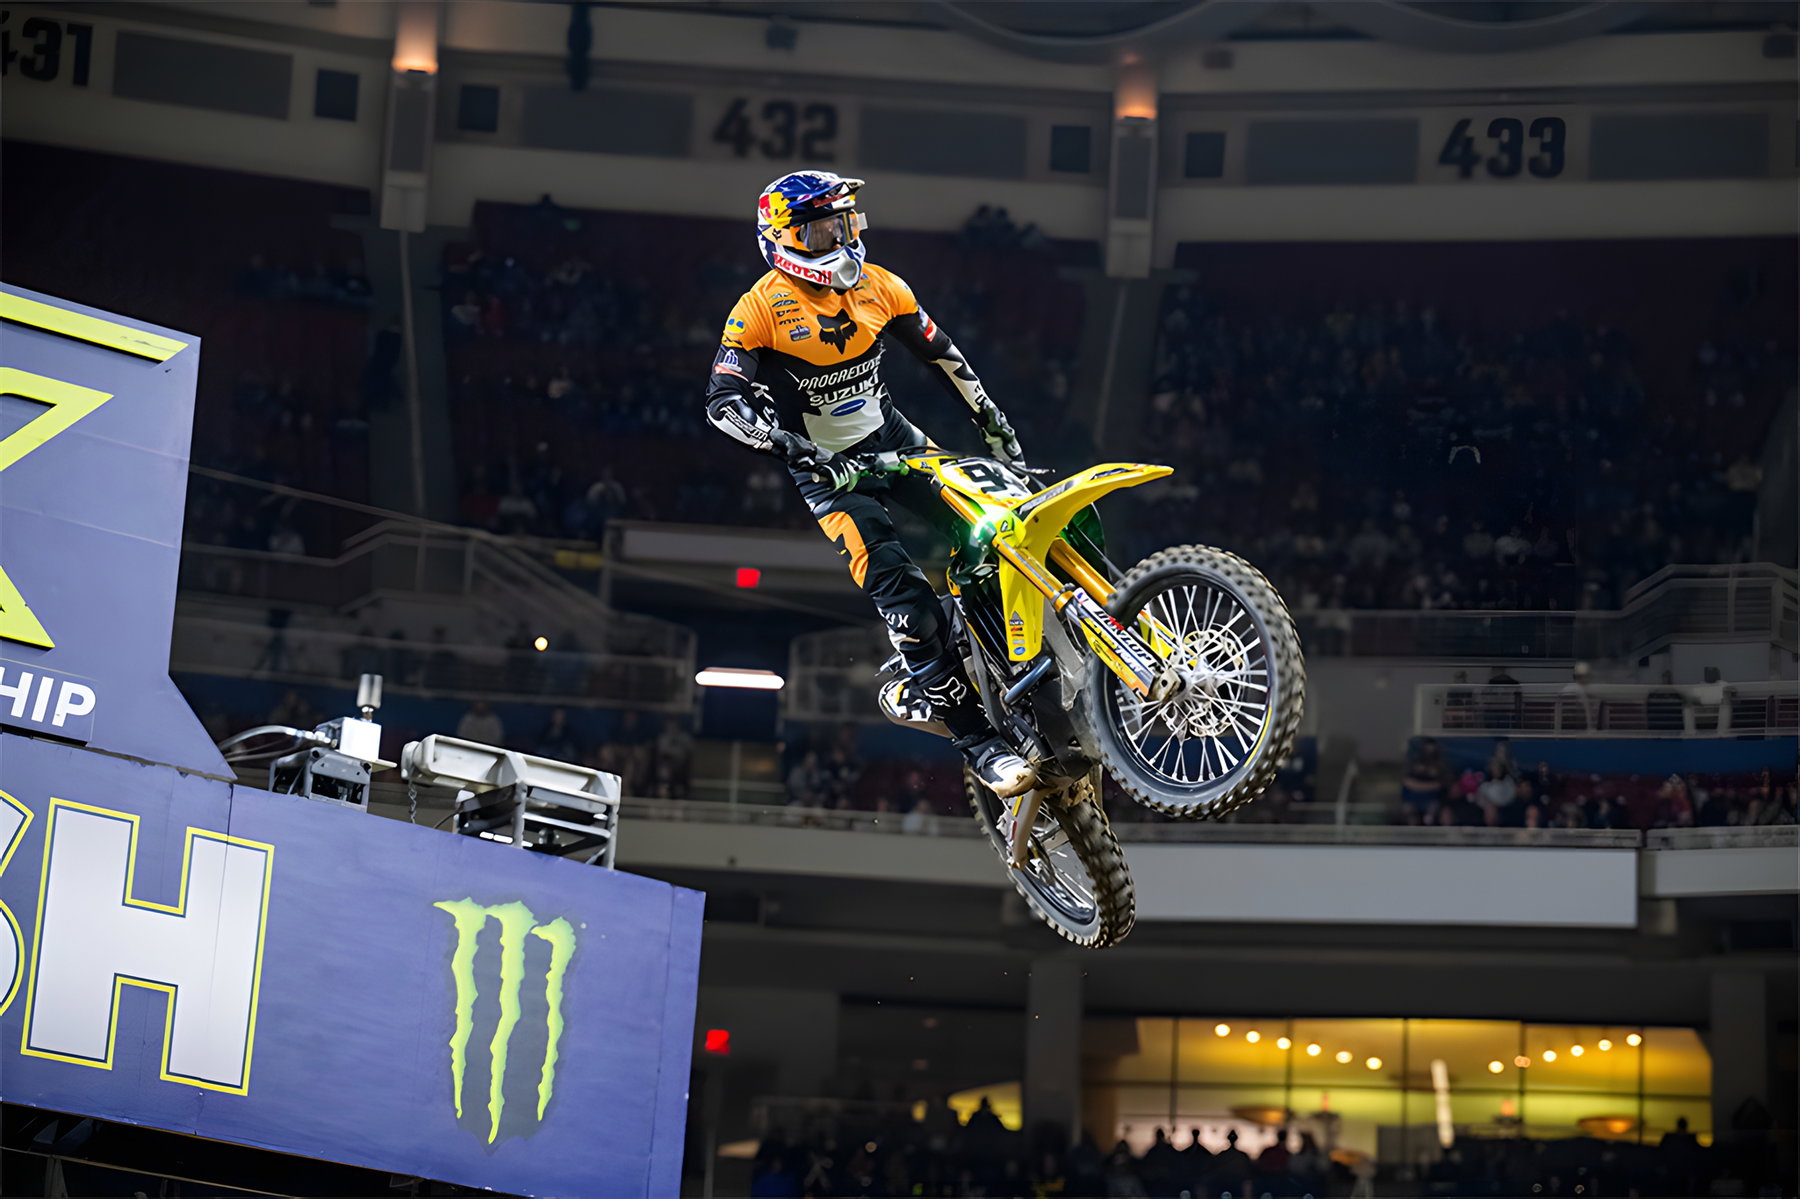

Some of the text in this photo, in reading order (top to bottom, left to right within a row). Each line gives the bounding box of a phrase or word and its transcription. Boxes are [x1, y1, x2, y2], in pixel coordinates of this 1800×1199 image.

[711, 98, 837, 163] 432
[1438, 117, 1566, 179] 433
[0, 666, 96, 727] HIP
[0, 789, 275, 1096] H
